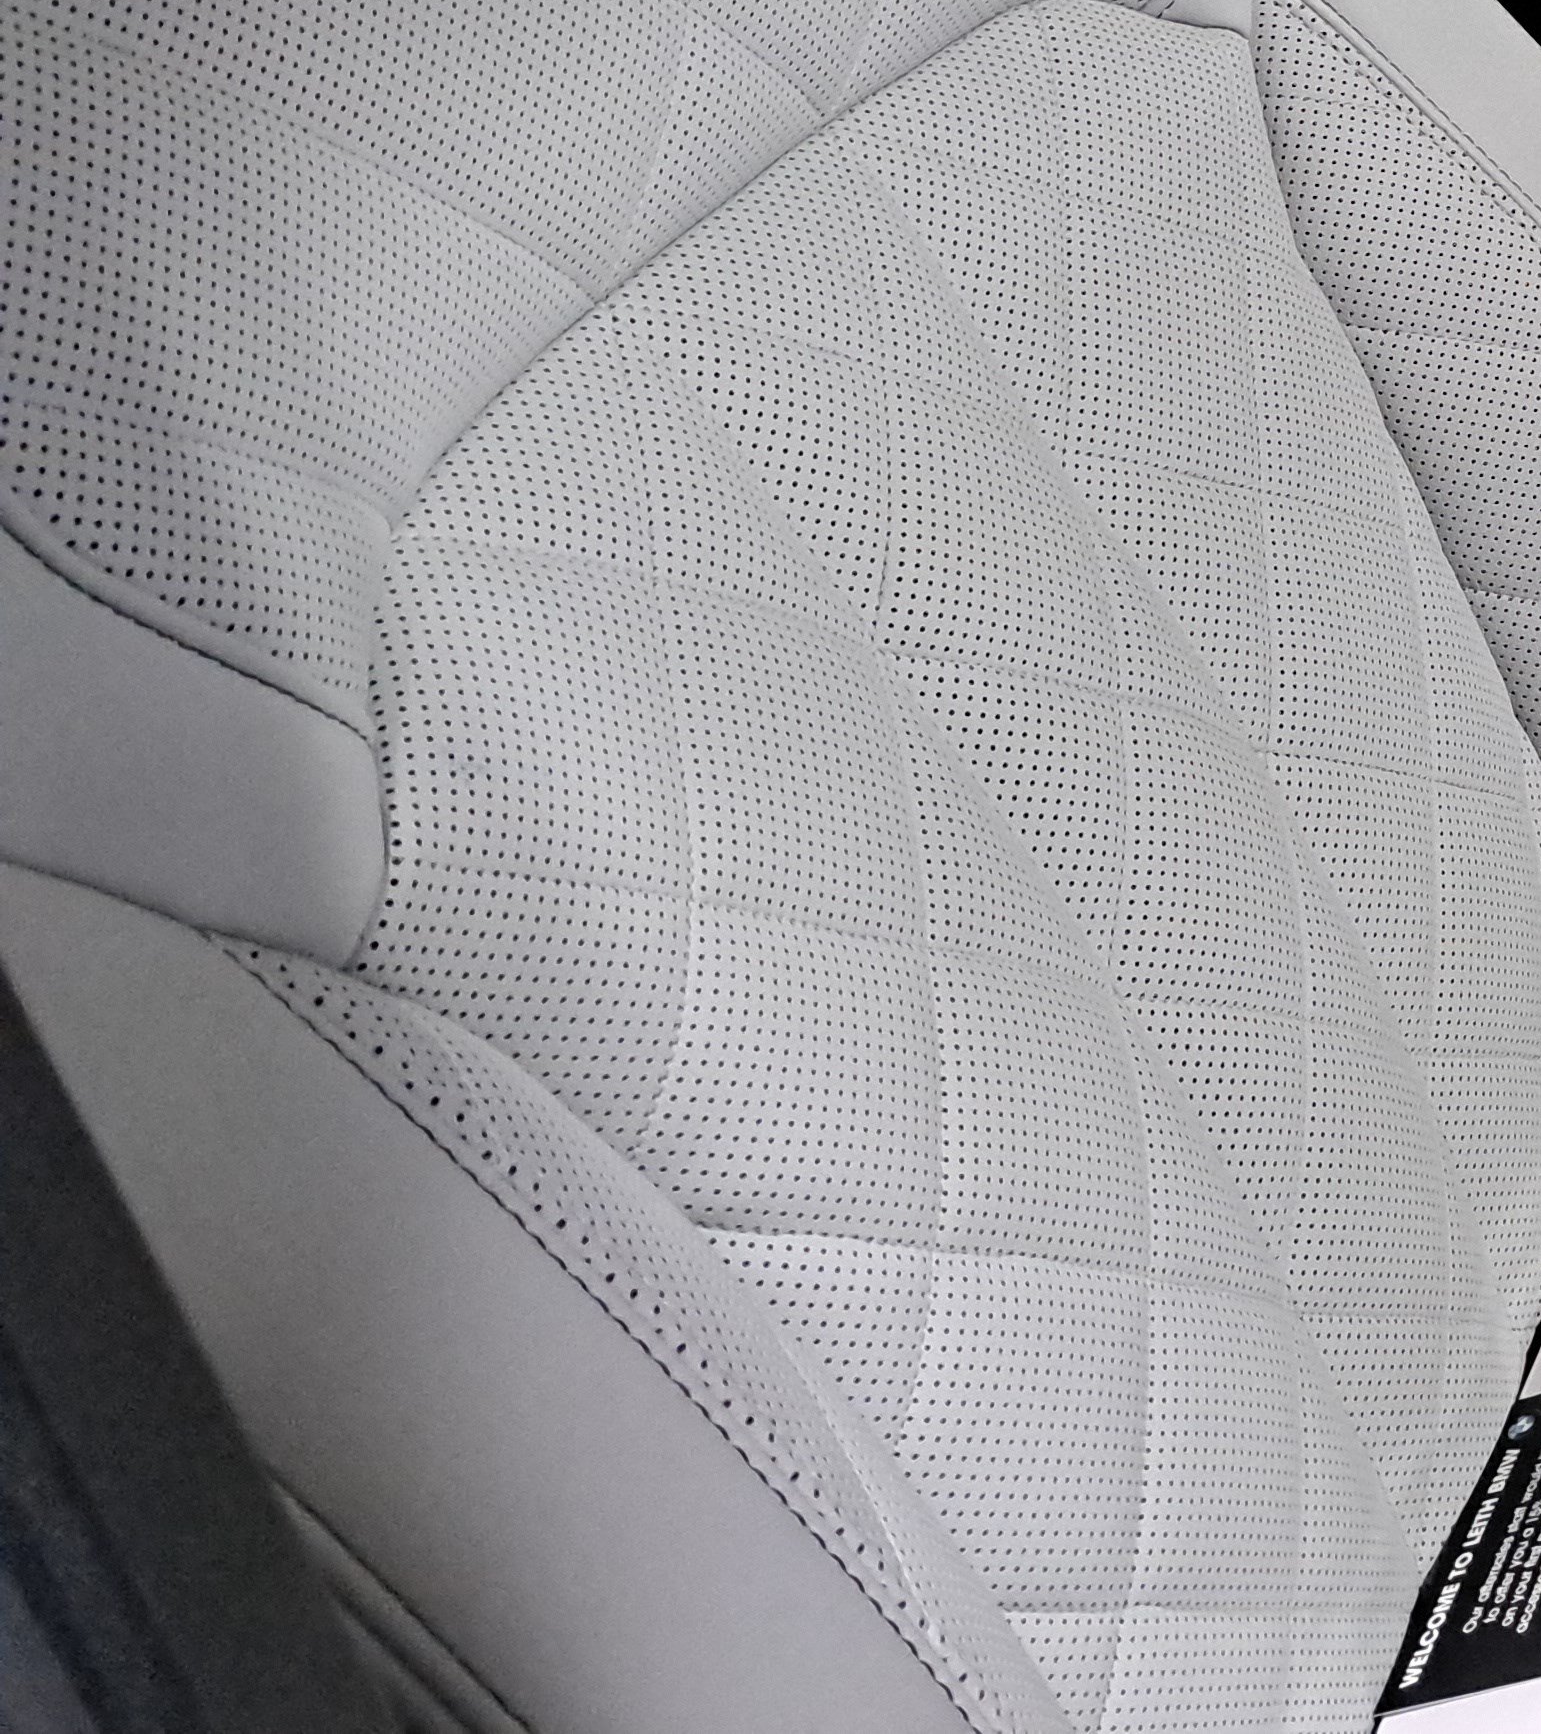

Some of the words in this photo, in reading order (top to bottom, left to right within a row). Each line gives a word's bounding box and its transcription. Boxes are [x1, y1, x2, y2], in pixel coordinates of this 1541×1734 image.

[1399, 1583, 1460, 1688] WELCOME
[1448, 1552, 1473, 1580] TO
[1463, 1498, 1499, 1547] LEITH
[1488, 1449, 1520, 1493] BMW
[1483, 1607, 1500, 1623] to
[1494, 1573, 1515, 1604] offer
[1509, 1541, 1529, 1568] you
[1523, 1527, 1534, 1538] a
[1502, 1607, 1518, 1627] on
[1511, 1571, 1532, 1603] your
[1462, 1607, 1483, 1633] Our
